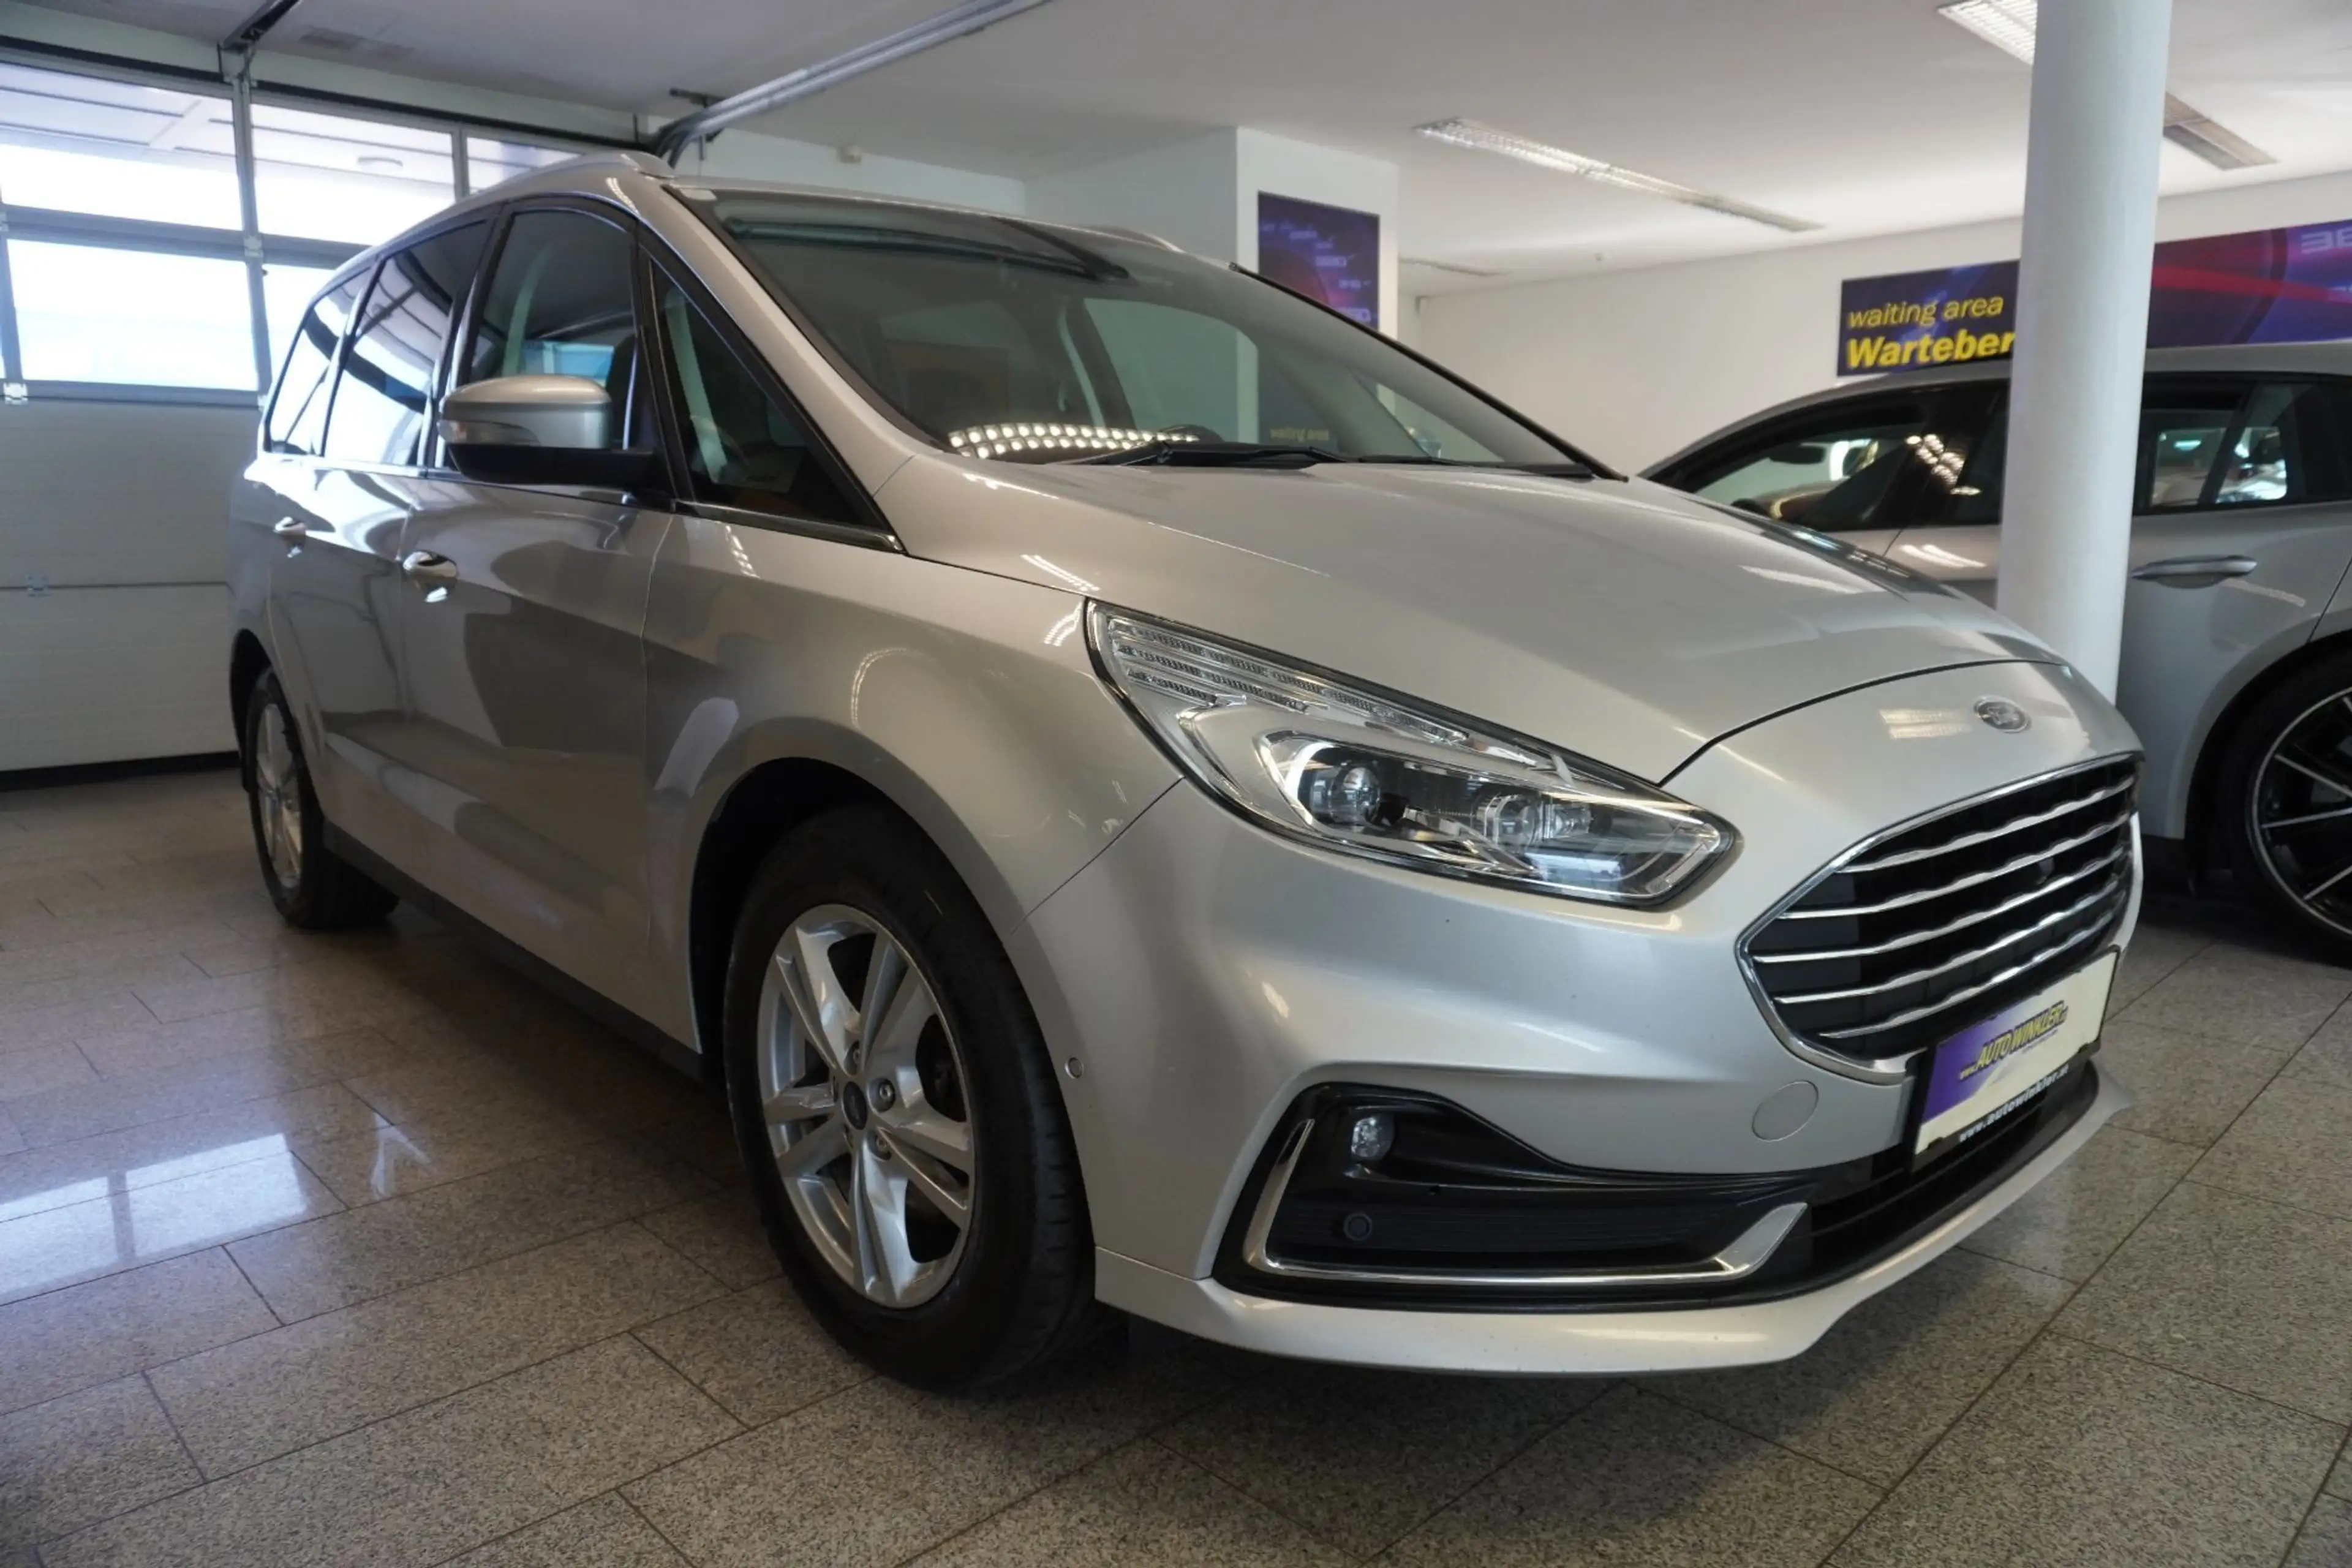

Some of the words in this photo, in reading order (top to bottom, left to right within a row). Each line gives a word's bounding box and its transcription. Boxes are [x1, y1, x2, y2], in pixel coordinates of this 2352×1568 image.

[1848, 300, 1939, 328] waiting
[1942, 295, 2005, 321] area
[1847, 329, 2016, 369] Warteber
